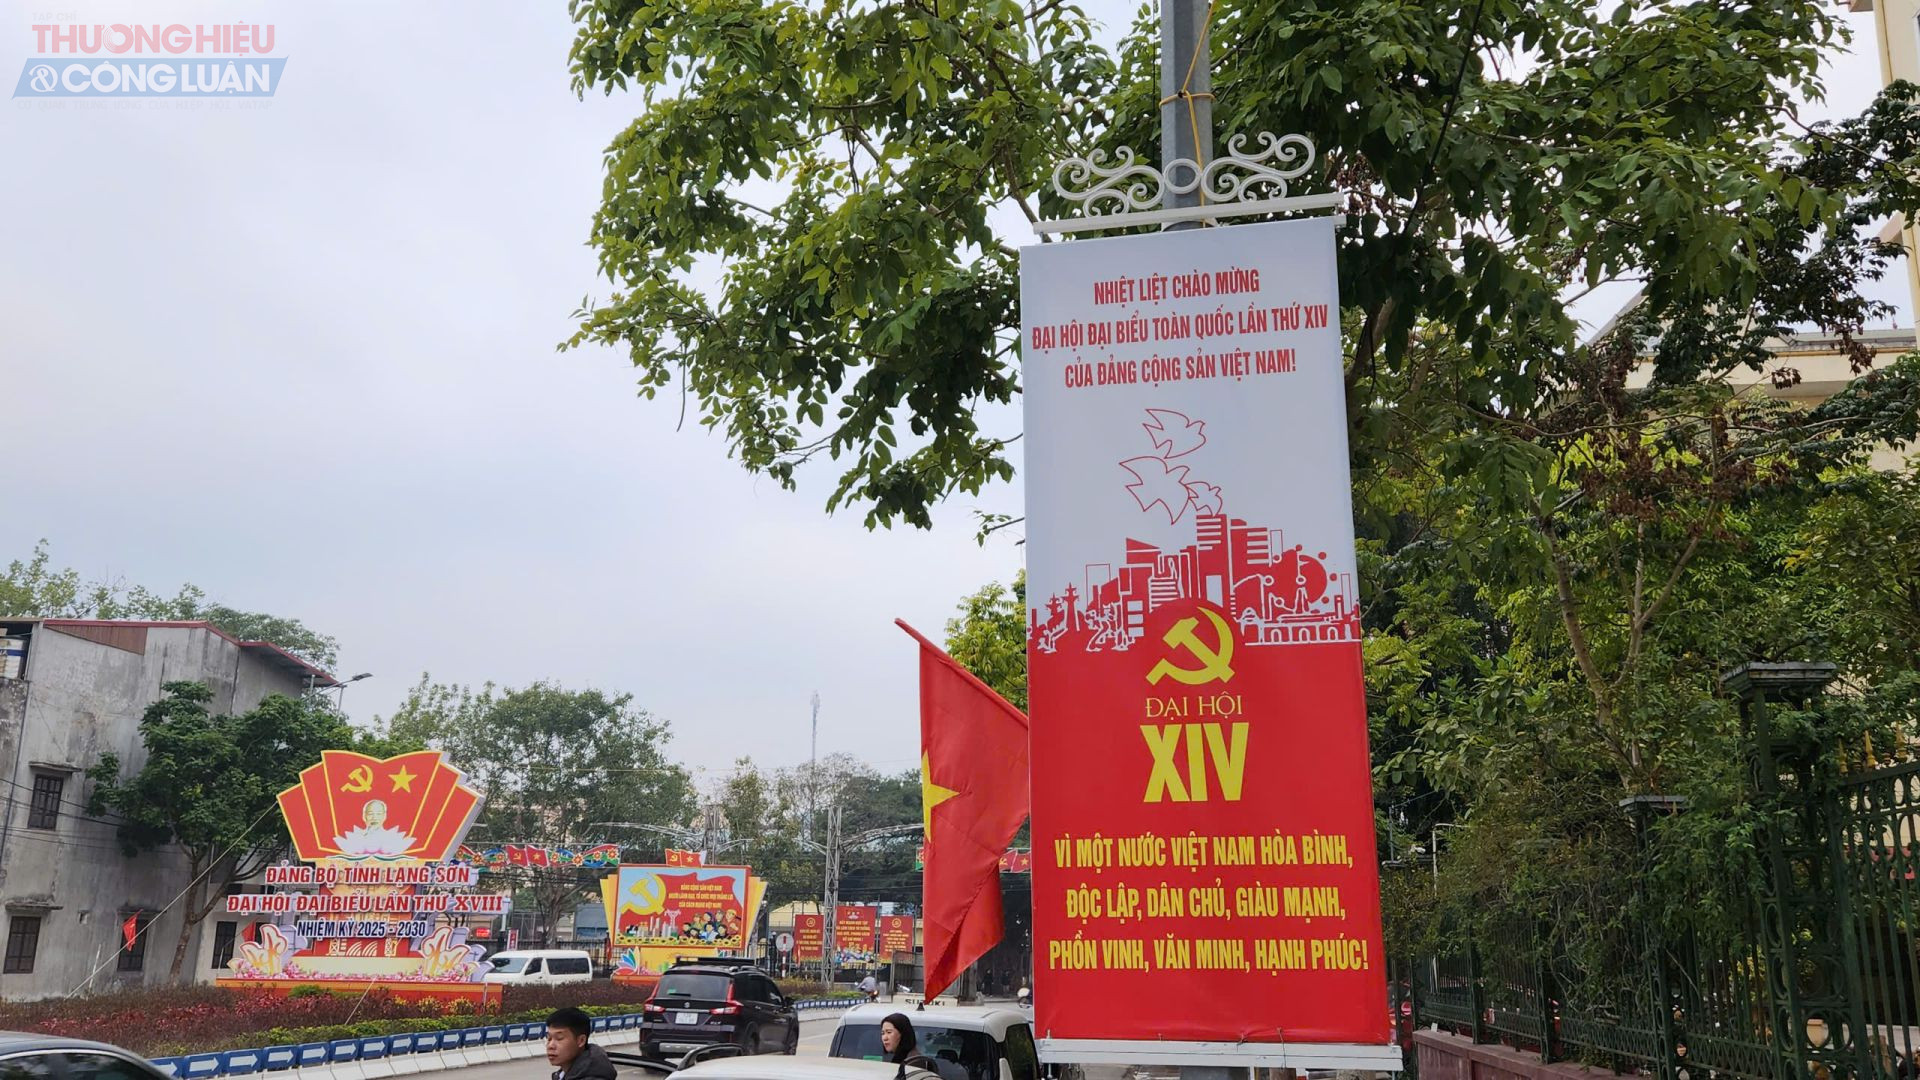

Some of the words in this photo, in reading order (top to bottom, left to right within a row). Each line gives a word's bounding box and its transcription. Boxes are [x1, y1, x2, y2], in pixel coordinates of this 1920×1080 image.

[1094, 275, 1135, 308] NHIỆT
[1139, 273, 1168, 305] LIỆT
[1172, 268, 1211, 299] CHÀO
[1216, 266, 1260, 295] MỪNG
[1032, 325, 1056, 354] ĐẠI
[1060, 319, 1084, 352] HỘI
[1088, 321, 1112, 349] ĐẠI
[1116, 310, 1148, 344] BIỂU
[1152, 311, 1190, 341] TOÀN
[1195, 304, 1234, 341] QUỐC
[1238, 302, 1268, 334] LẦN
[1271, 302, 1300, 331] THỨ
[1304, 304, 1328, 330] XIV
[1065, 354, 1093, 388] CỦA
[1097, 353, 1137, 386] ĐẢNG
[1141, 354, 1181, 388] CỘNG
[1186, 347, 1216, 380] SẢN
[1220, 348, 1250, 381] VIỆT
[1255, 348, 1296, 375] NAM!
[1145, 696, 1188, 721] ĐẠI
[1199, 691, 1243, 719] HỘI
[1139, 722, 1249, 803] XIV
[1054, 833, 1072, 868] VÌ
[1076, 832, 1113, 874] MỘT
[1118, 831, 1166, 868] NƯỚC
[1170, 831, 1208, 873] VIỆT
[1213, 836, 1255, 866] NAM
[1261, 828, 1298, 866] HÒA
[1303, 829, 1353, 869] BÌNH,
[266, 861, 311, 883] ĐẢNG
[316, 864, 337, 887] BỘ
[344, 862, 380, 883] TỈNH
[386, 867, 430, 887] LẠNG
[436, 864, 470, 883] SƠN
[228, 895, 257, 915] ĐẠI
[261, 892, 290, 915] HỘI
[296, 895, 324, 915] ĐẠI
[330, 890, 370, 911] BIỂU
[374, 890, 409, 911] LẦN
[415, 893, 449, 911] THỨ
[454, 896, 502, 911] XVIII
[1066, 883, 1101, 924] ĐỘC
[1106, 882, 1142, 924] LẬP,
[1146, 881, 1184, 918] DÂN
[1189, 877, 1231, 920] CHỦ,
[1236, 881, 1278, 917] GIÀU
[1284, 887, 1346, 923] MẠNH,
[298, 917, 335, 940] NHIỆM
[357, 921, 385, 936] 2025
[398, 921, 426, 936] 2030
[1049, 930, 1097, 970] PHỒN
[1101, 939, 1150, 973] VINH,
[1153, 933, 1190, 970] VĂN
[1195, 939, 1250, 972] MINH,
[1255, 939, 1305, 976] HẠNH
[1311, 933, 1369, 970] PHÚC!
